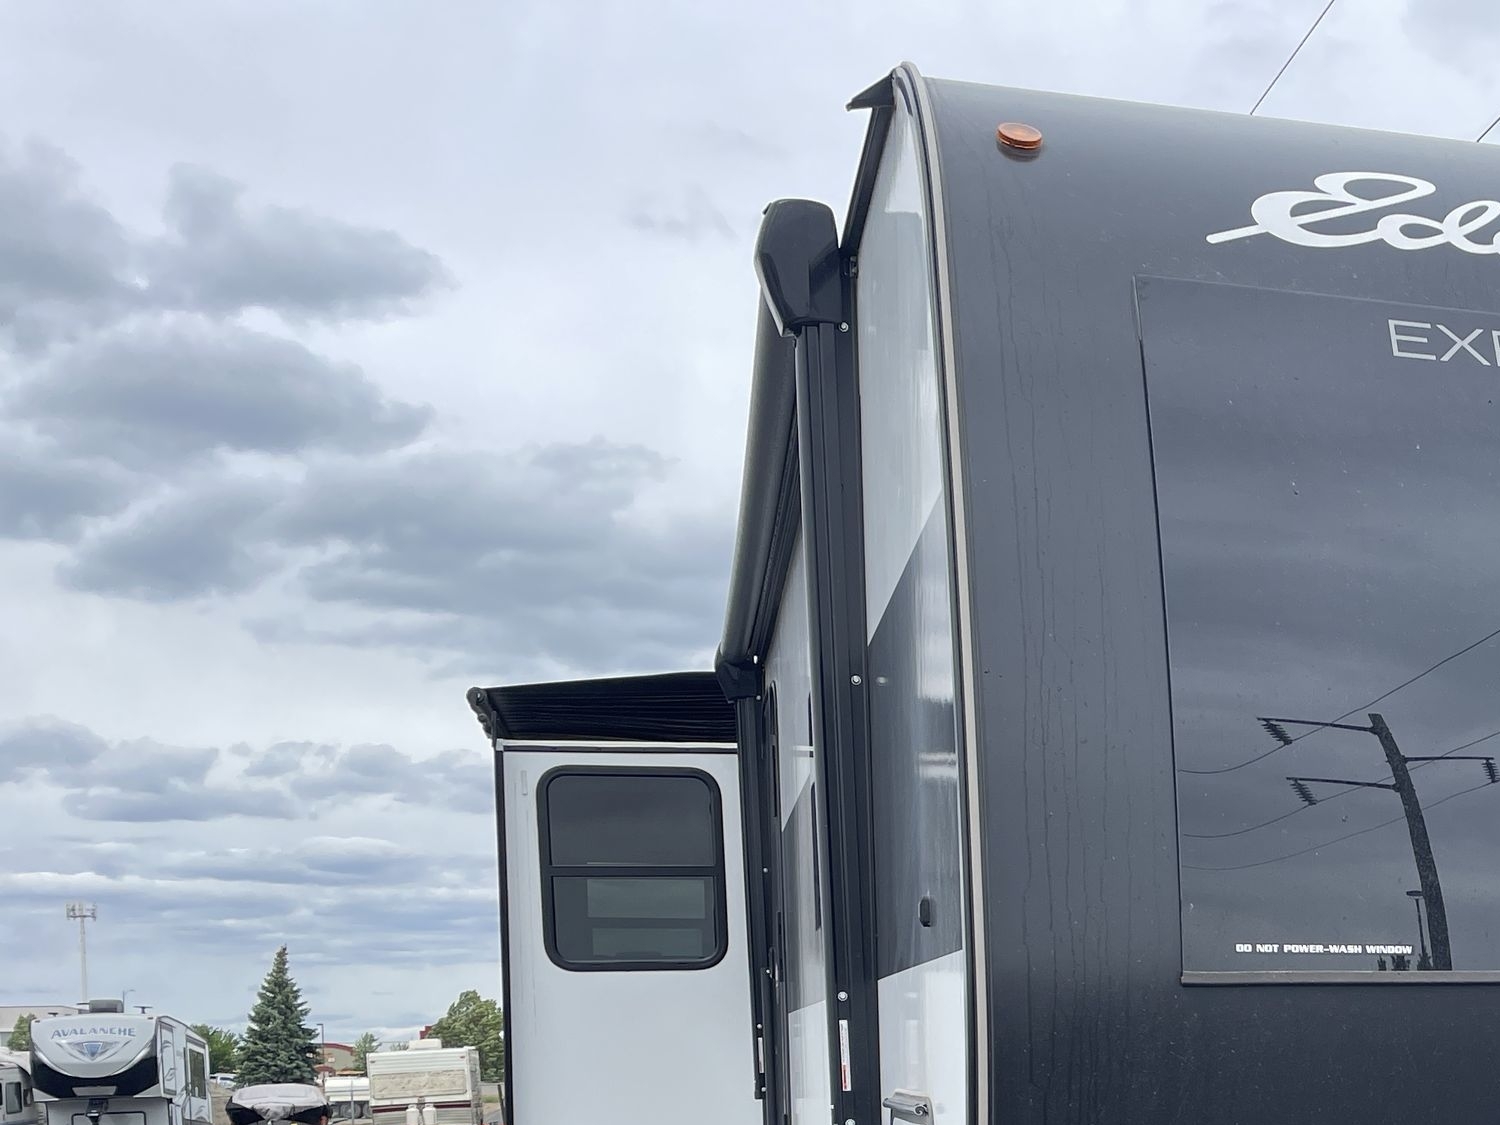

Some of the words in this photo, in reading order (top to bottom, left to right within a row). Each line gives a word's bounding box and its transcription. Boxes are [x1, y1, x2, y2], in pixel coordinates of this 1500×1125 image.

[1235, 943, 1253, 953] DO
[1255, 943, 1280, 953] NOT
[1283, 944, 1363, 954] POWER-WASH
[1365, 945, 1413, 955] WINDOW
[51, 1027, 136, 1039] AVALANCHE
